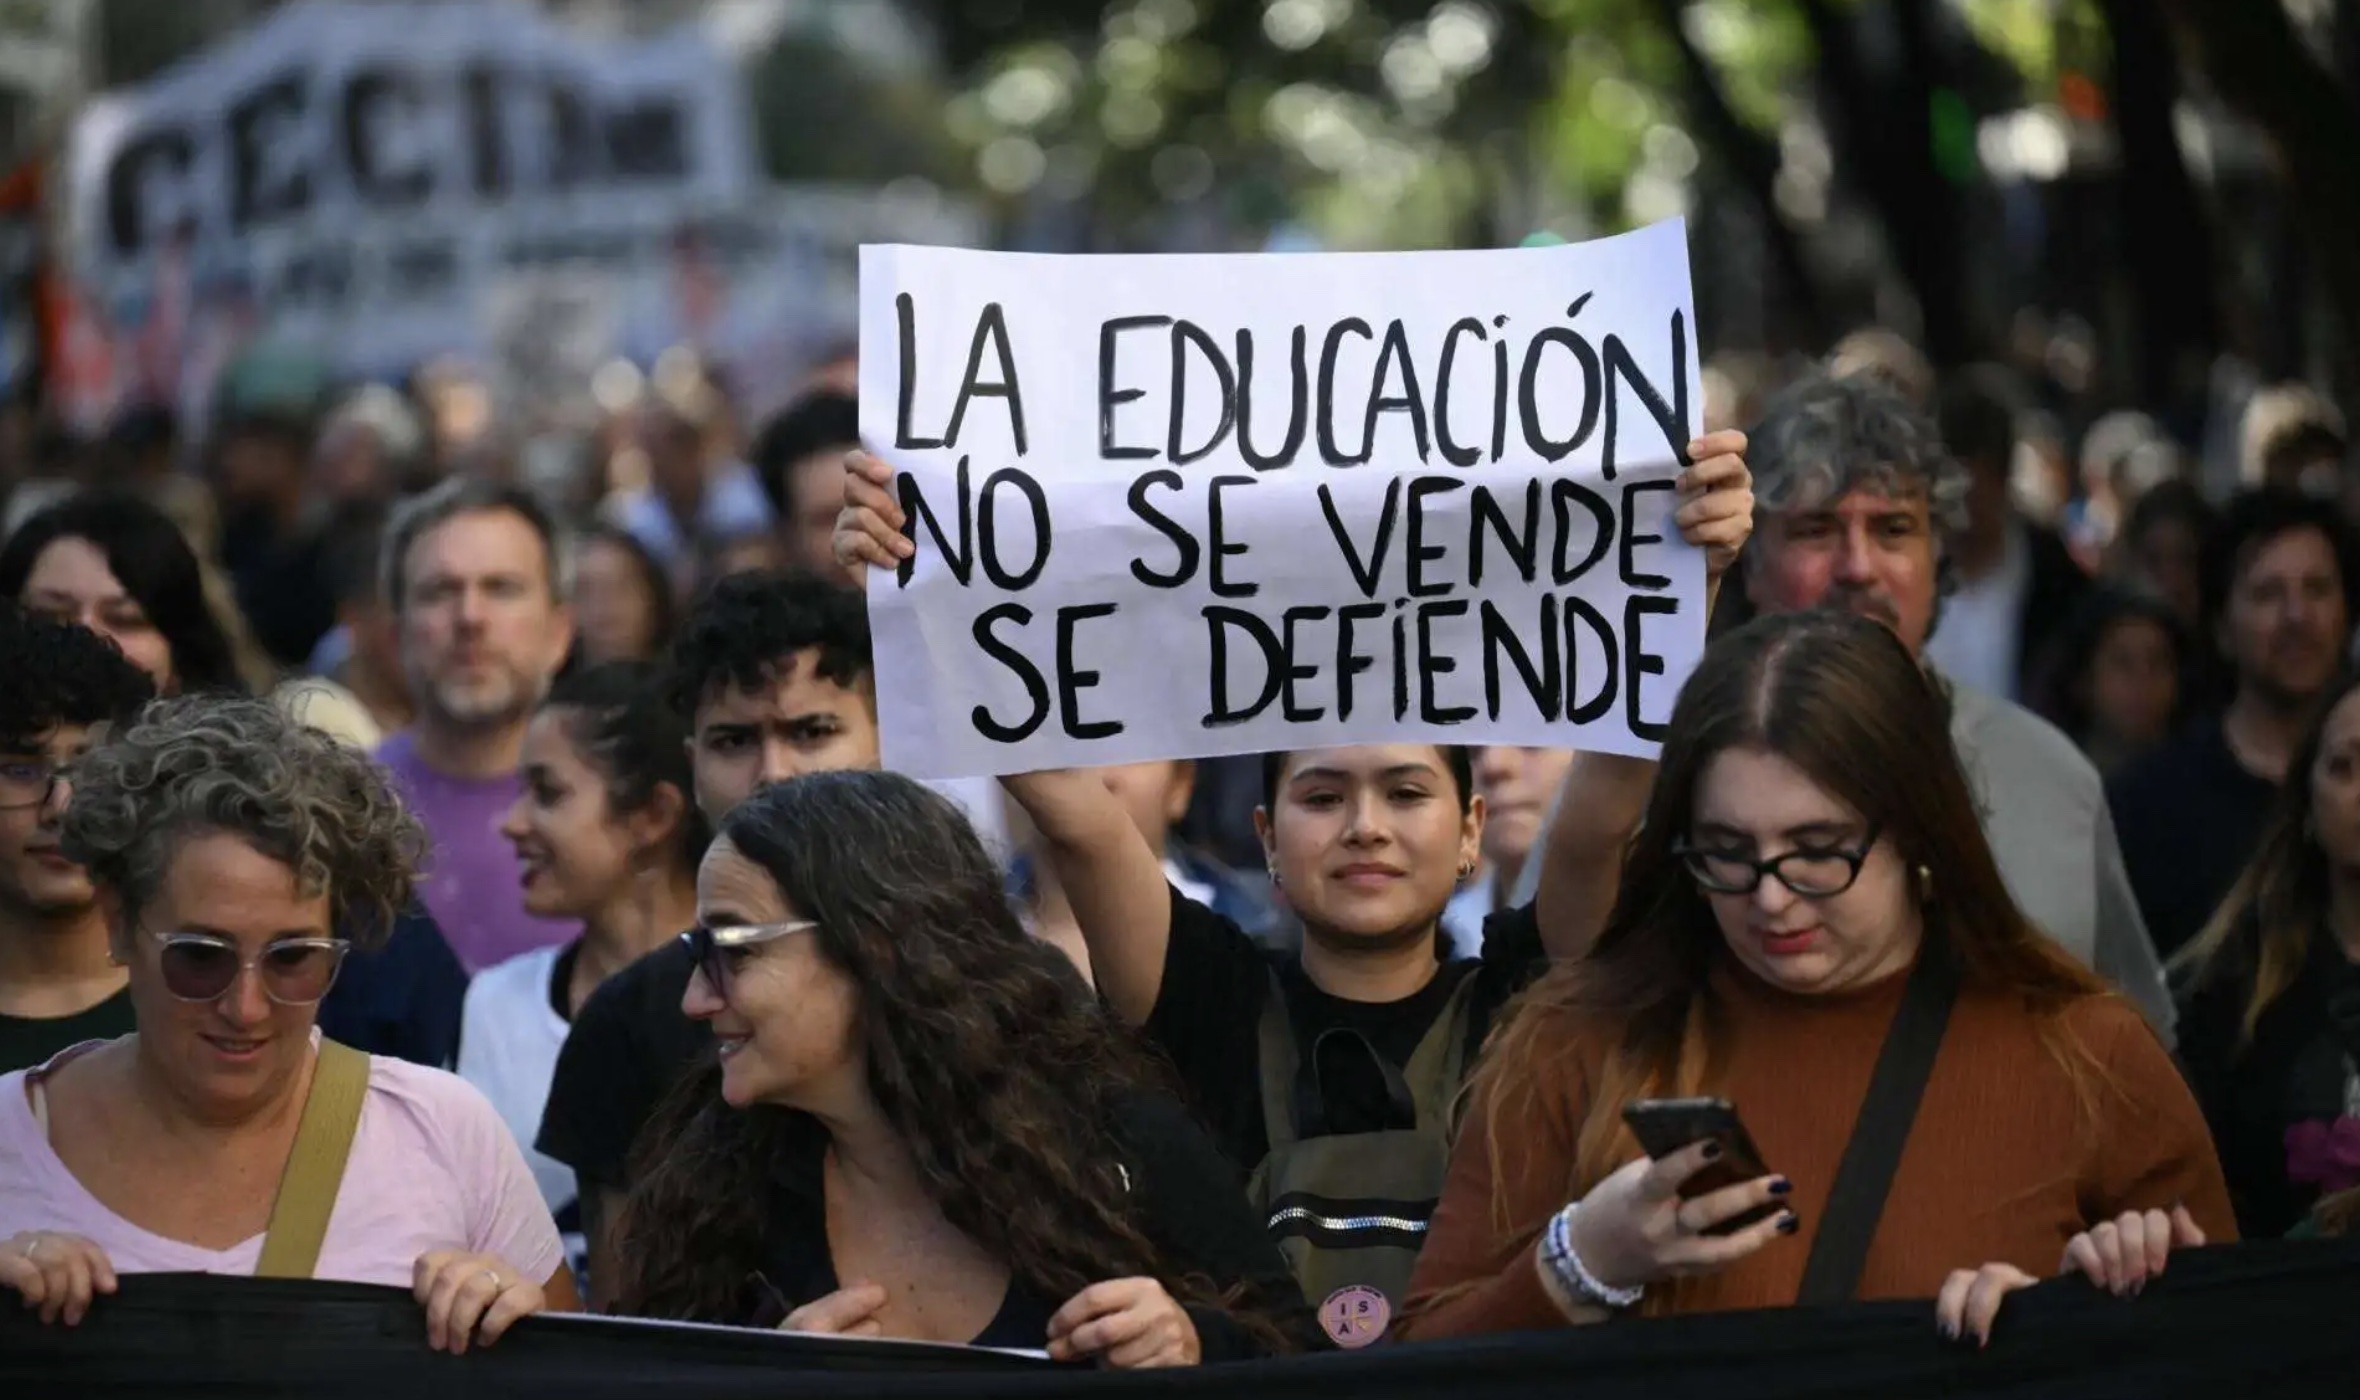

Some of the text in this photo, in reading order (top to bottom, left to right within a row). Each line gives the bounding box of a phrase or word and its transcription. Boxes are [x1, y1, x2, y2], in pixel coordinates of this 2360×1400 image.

[895, 292, 1027, 456] LA
[896, 455, 1678, 598] NO SE VENDE
[971, 602, 1125, 743] SE
